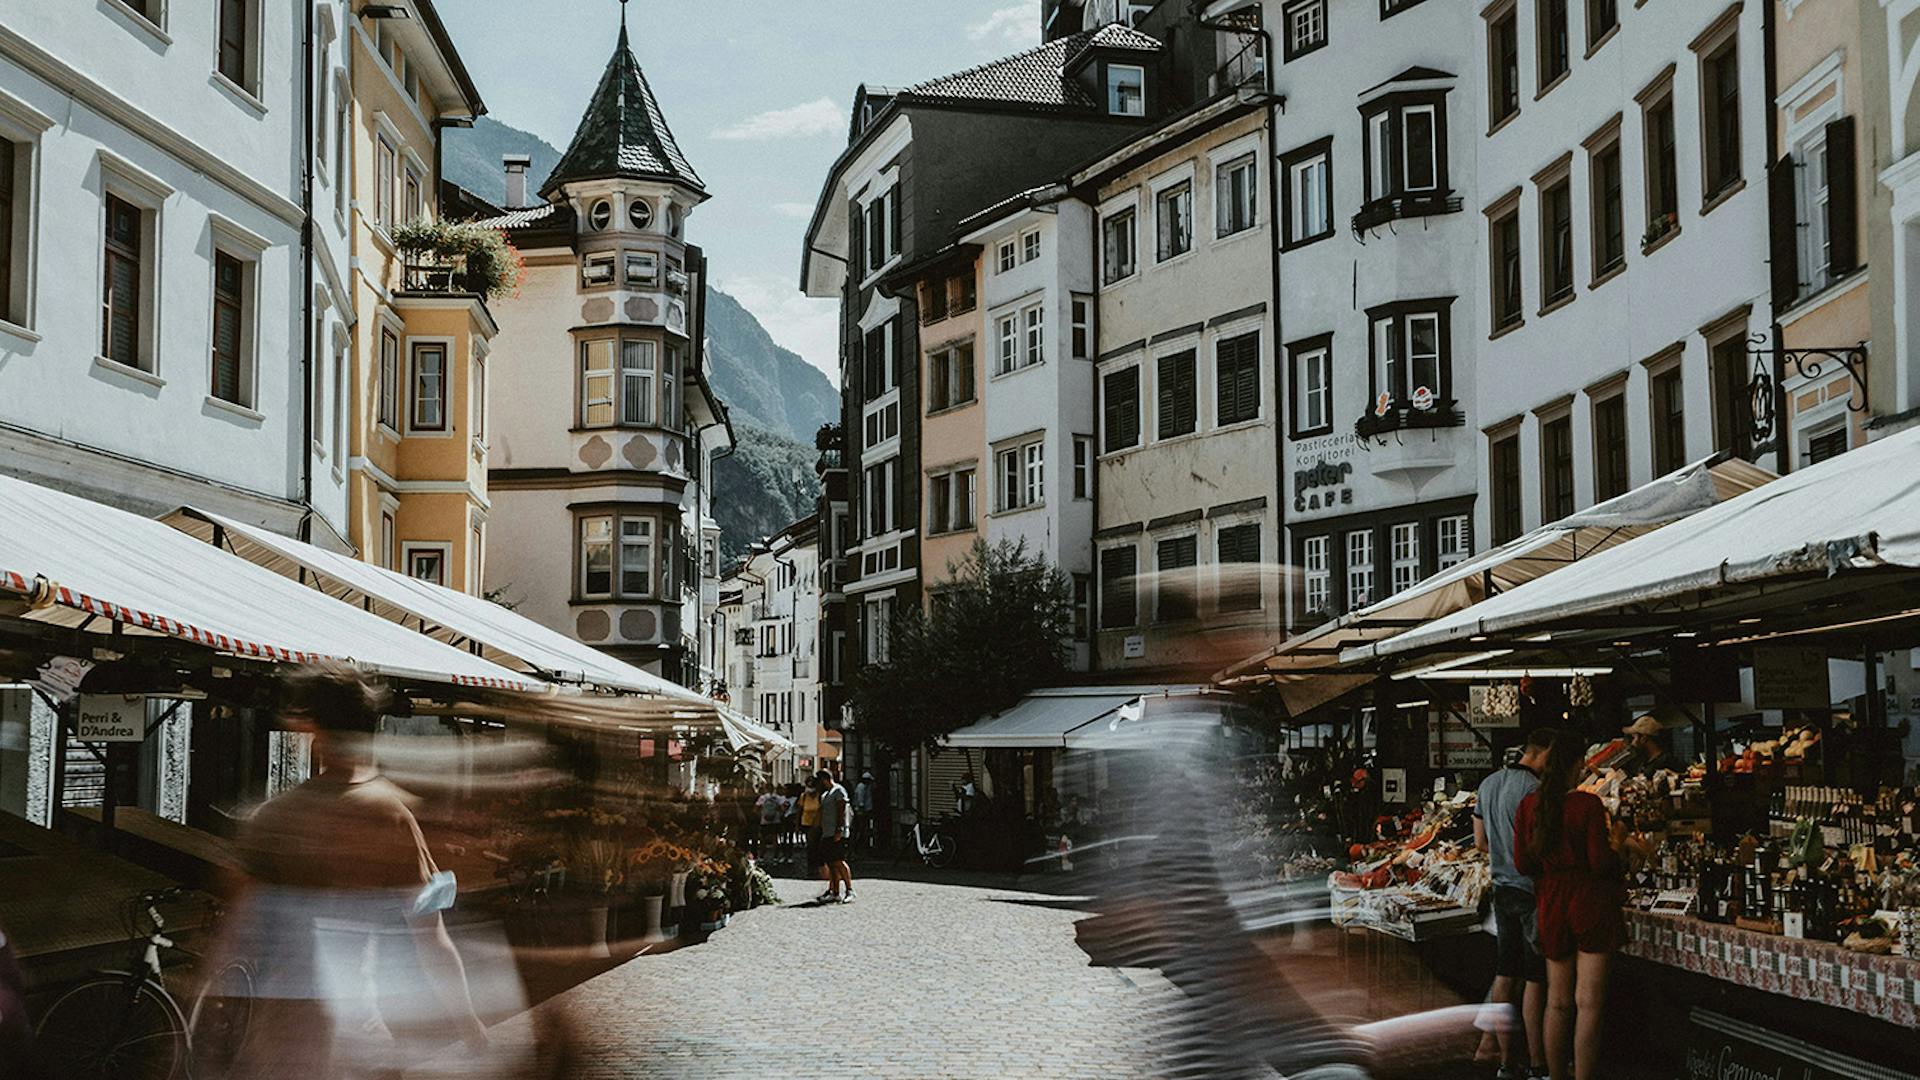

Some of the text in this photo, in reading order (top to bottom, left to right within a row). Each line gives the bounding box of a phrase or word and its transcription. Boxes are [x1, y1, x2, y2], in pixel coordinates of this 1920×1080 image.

[1296, 433, 1354, 452] Pasticceria
[1296, 445, 1354, 466] Konditorei
[81, 712, 122, 723] Perri &
[81, 726, 134, 737] D'Andrea
